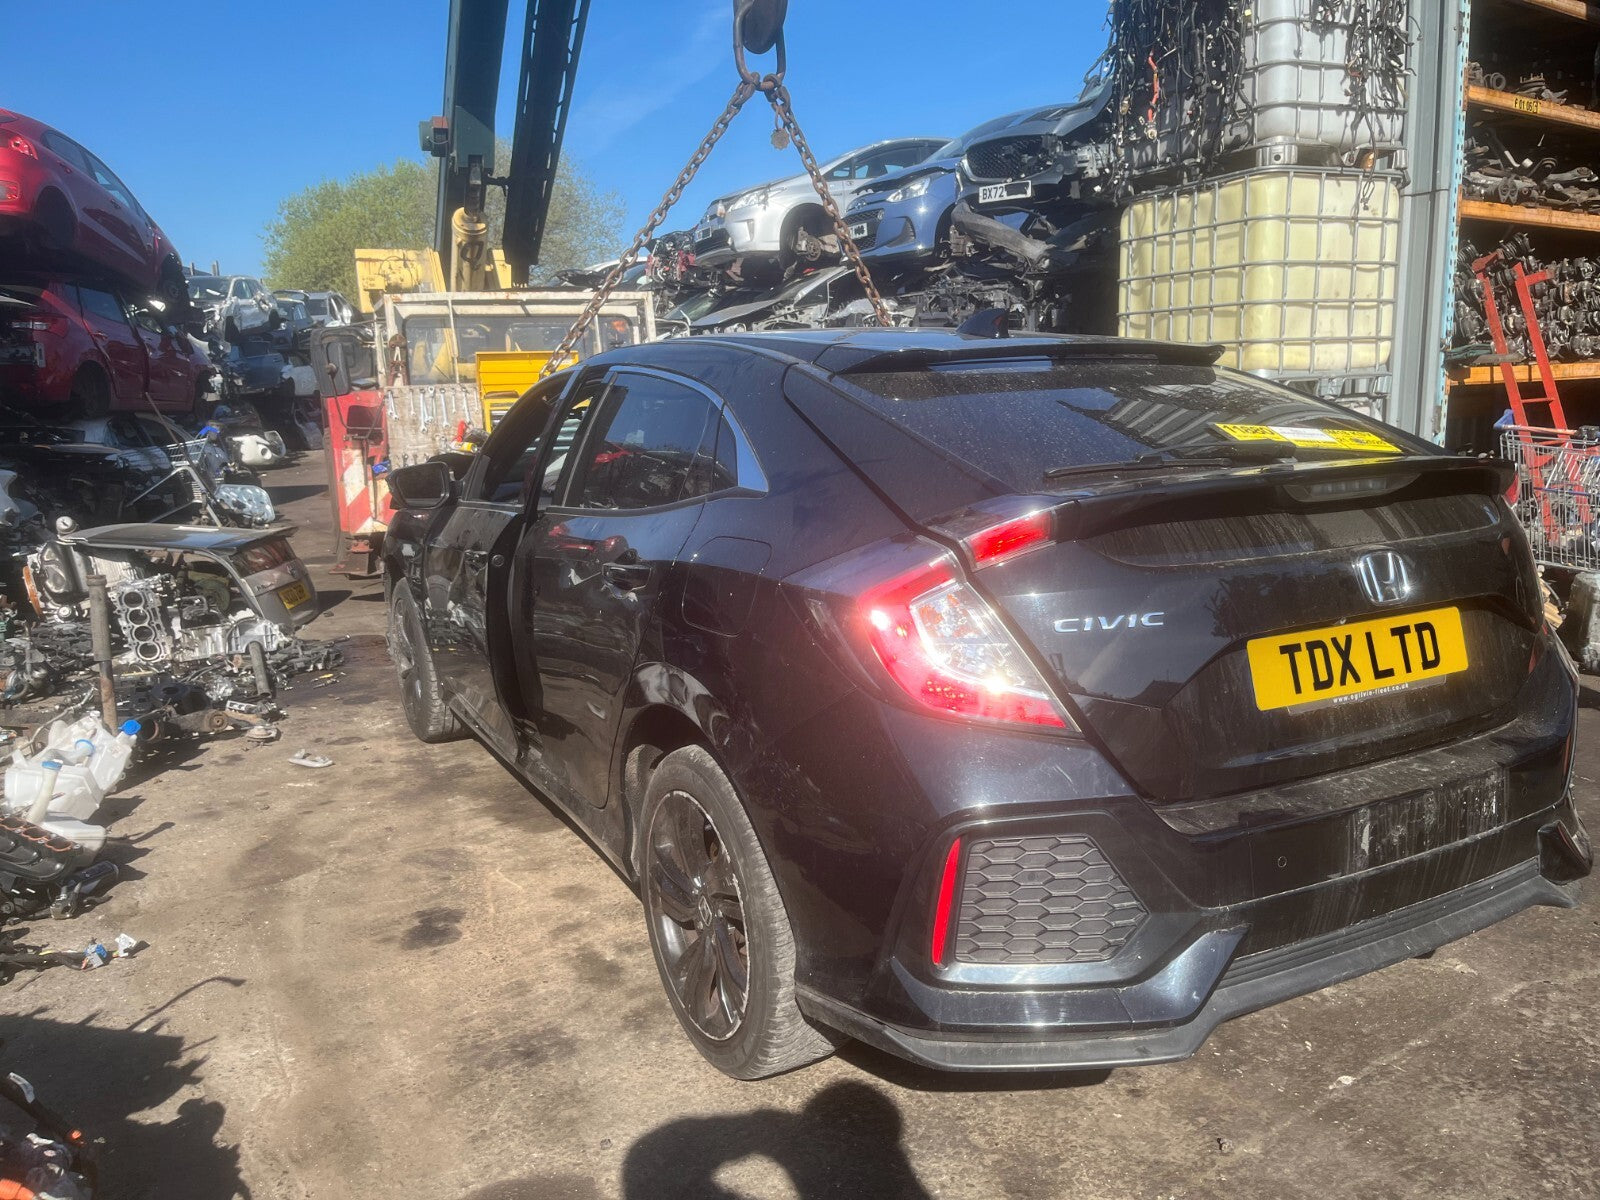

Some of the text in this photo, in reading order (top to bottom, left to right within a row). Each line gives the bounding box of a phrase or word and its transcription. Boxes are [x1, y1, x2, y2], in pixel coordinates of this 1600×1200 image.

[982, 186, 1004, 200] BX72
[1052, 611, 1165, 633] CIVIC
[1278, 621, 1441, 695] TDX LTD
